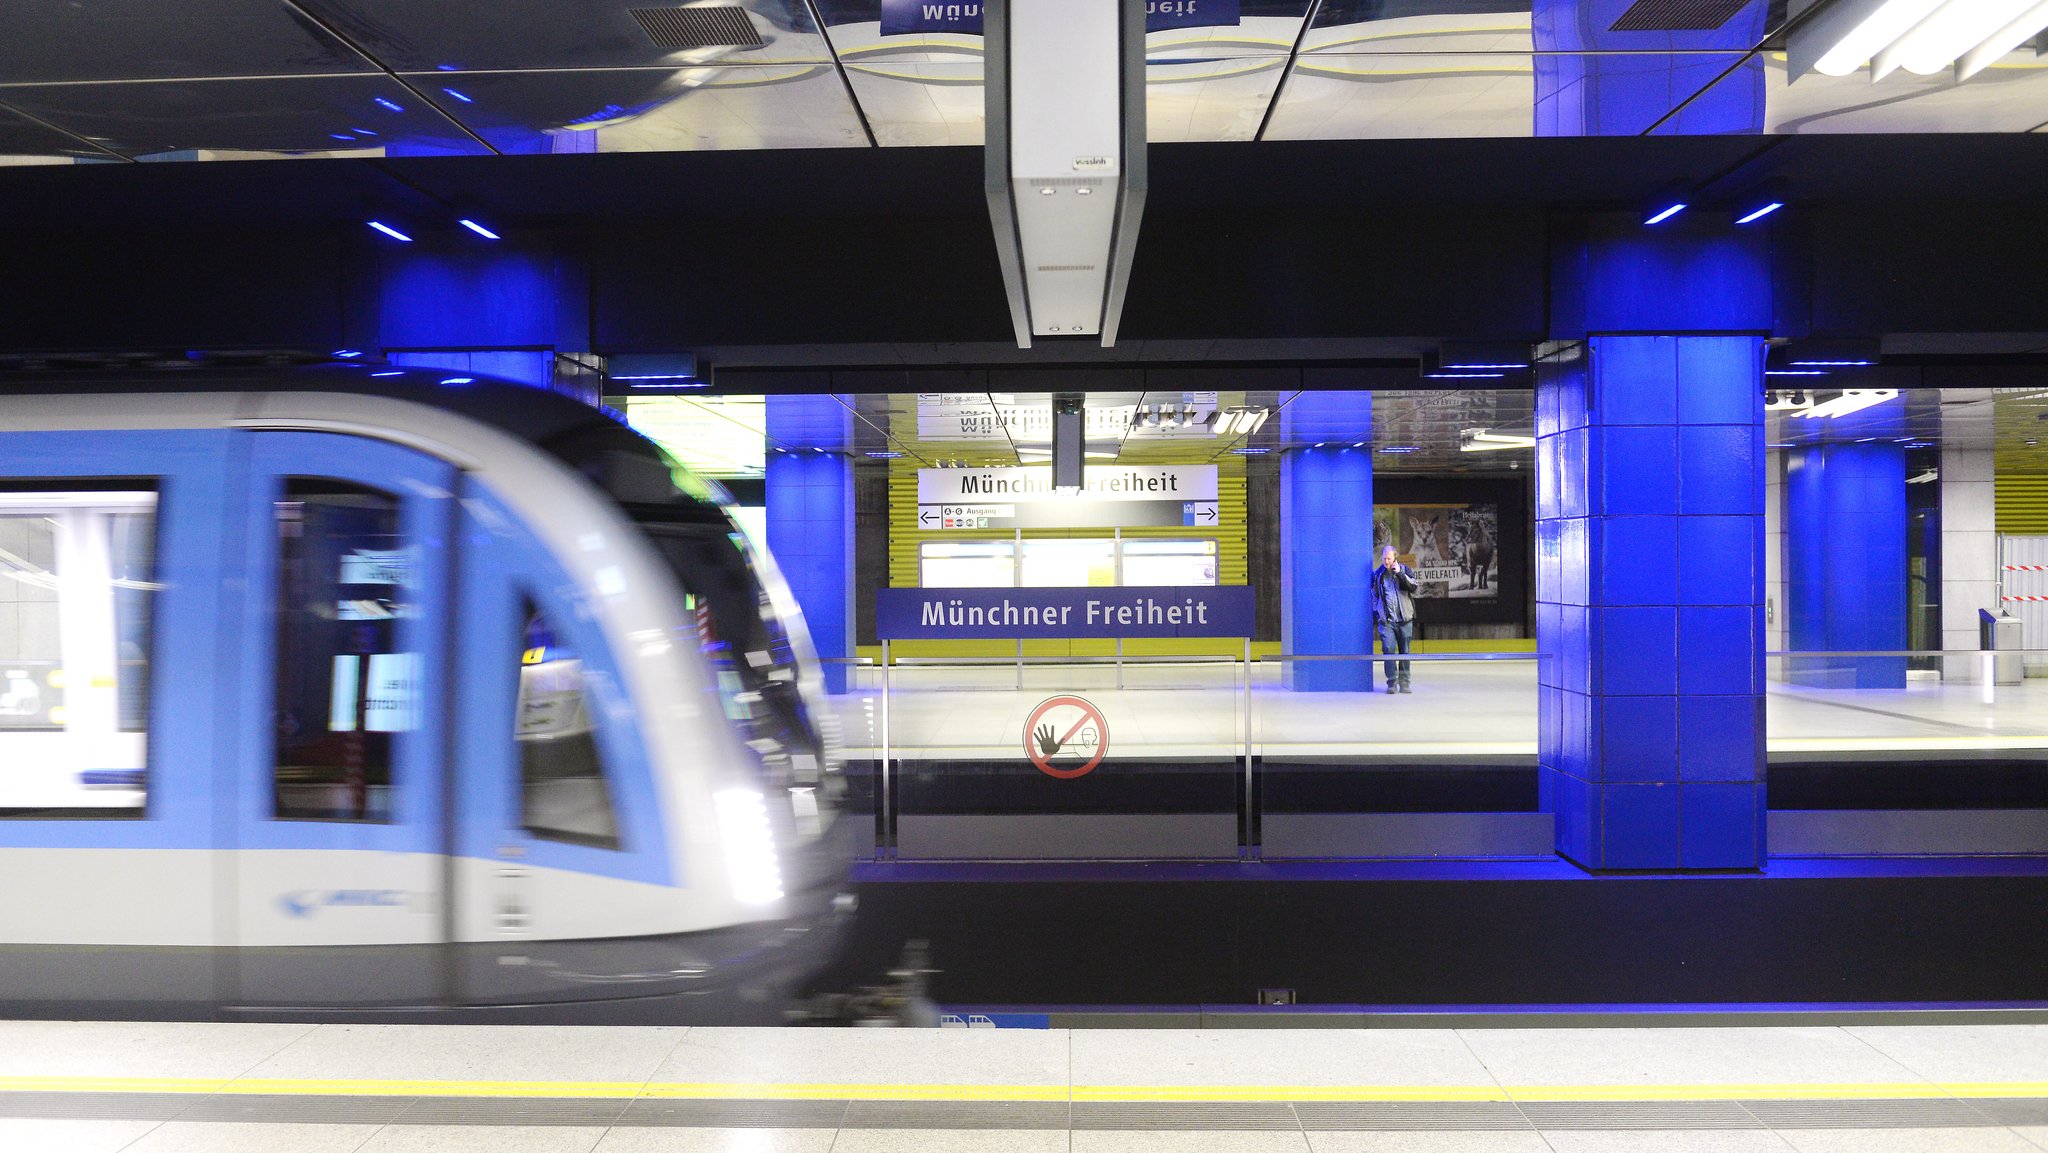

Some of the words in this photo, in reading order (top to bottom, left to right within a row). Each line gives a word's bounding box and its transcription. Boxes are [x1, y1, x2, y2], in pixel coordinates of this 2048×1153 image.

[1087, 472, 1178, 492] Freiheit
[967, 508, 996, 516] Ausgang
[921, 600, 1072, 626] Münchner
[1086, 599, 1208, 625] Freiheit
